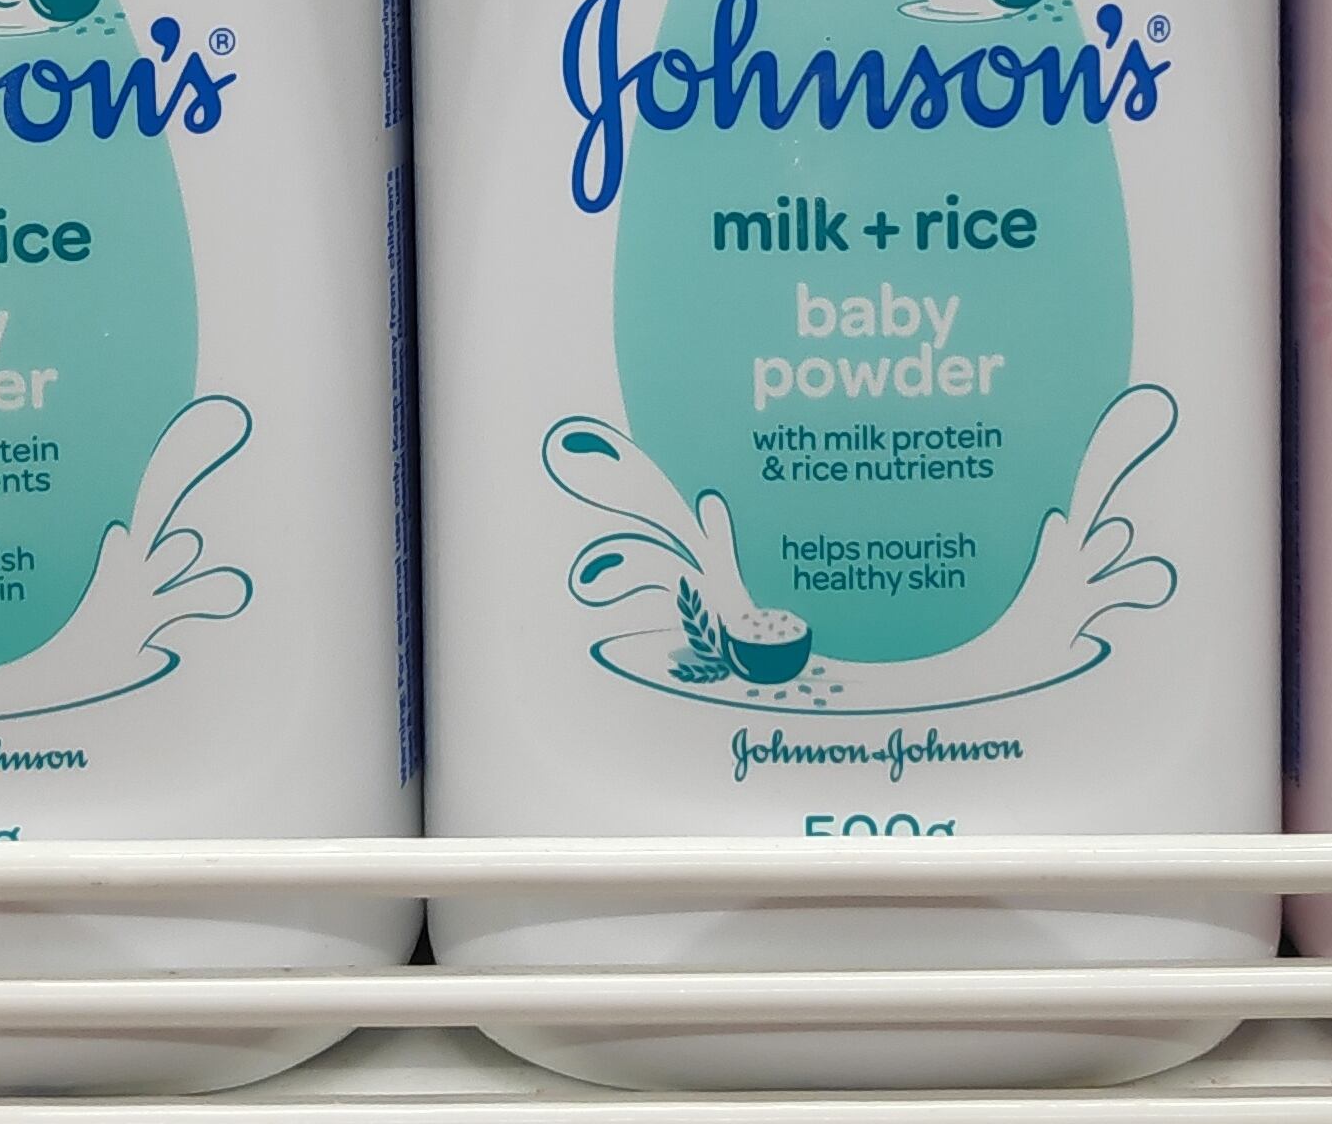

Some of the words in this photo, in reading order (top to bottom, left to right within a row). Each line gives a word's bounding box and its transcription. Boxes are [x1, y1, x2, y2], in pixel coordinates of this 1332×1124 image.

[713, 195, 848, 251] milk
[863, 211, 899, 251] +
[915, 194, 1038, 249] rice
[797, 283, 960, 349] baby
[753, 342, 1005, 411] powder
[753, 424, 815, 451] with
[823, 423, 886, 451] milk
[892, 423, 1003, 457] protein
[761, 457, 785, 482] &
[790, 456, 847, 482] rice
[855, 453, 994, 481] nutrients
[782, 534, 860, 562] helps
[867, 532, 976, 559] nourish
[794, 565, 902, 596] healthy
[908, 563, 966, 589] skin
